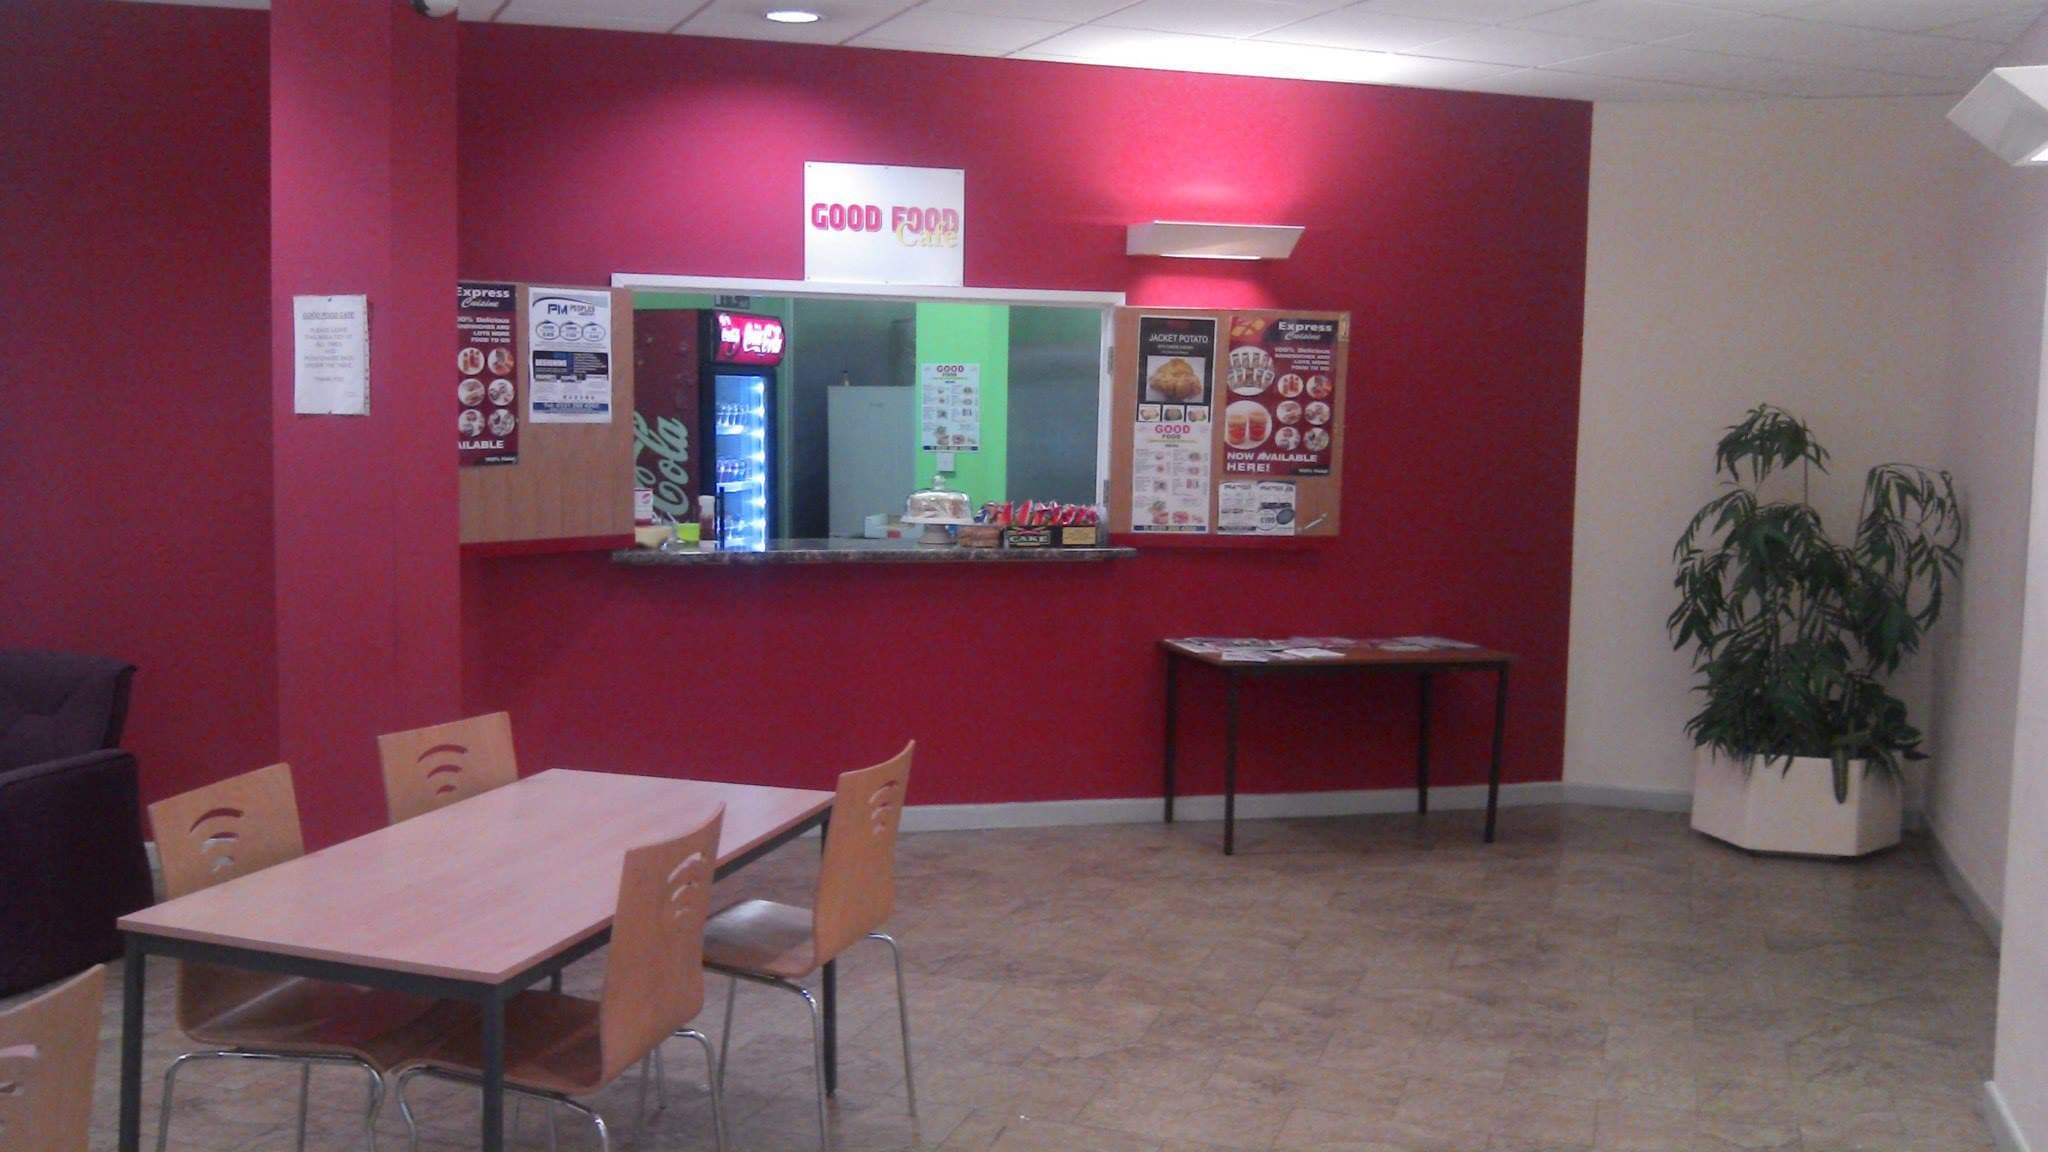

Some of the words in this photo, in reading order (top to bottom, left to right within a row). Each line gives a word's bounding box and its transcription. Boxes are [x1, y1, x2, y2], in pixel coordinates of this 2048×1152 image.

[811, 202, 882, 232] GOOD
[892, 206, 959, 234] FOOD
[1278, 321, 1332, 333] Express
[1149, 334, 1178, 343] JACKET
[1179, 335, 1208, 344] POTATO
[936, 365, 965, 373] GOOD
[1155, 424, 1190, 434] GOOD
[1227, 452, 1255, 461] NOW
[1257, 452, 1319, 463] AVAILABLE
[1227, 462, 1270, 472] HERE!
